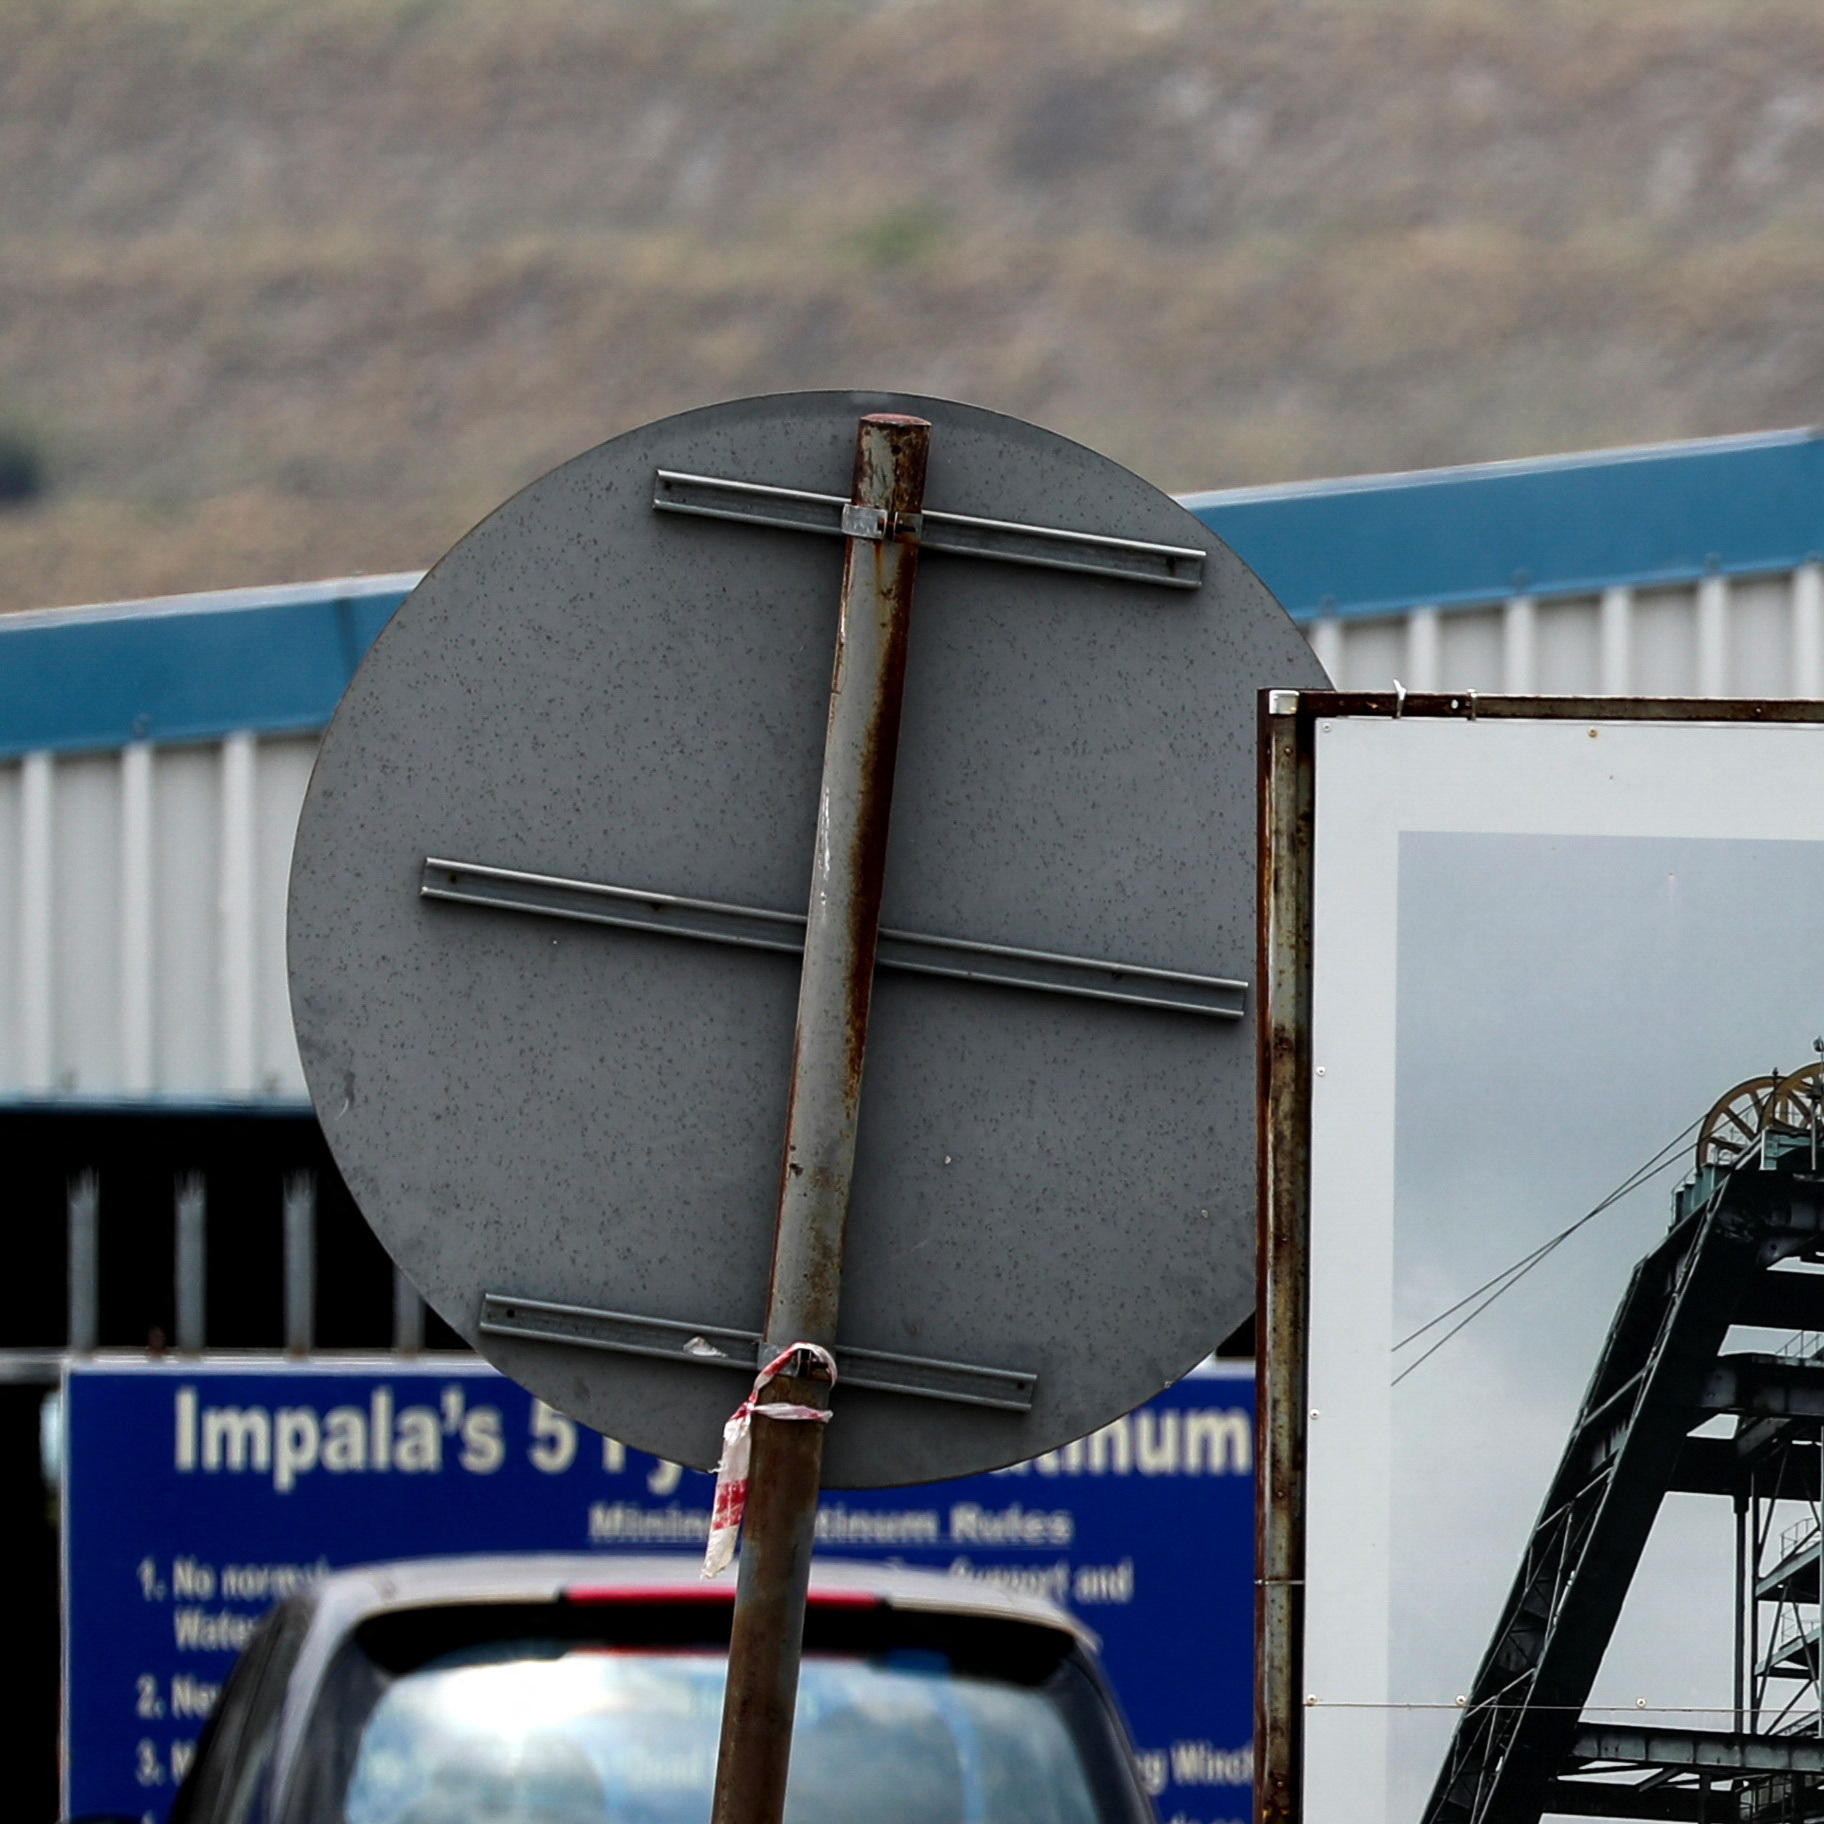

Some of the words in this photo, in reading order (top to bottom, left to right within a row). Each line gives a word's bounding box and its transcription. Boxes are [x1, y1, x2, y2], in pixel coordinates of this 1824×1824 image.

[174, 1386, 505, 1492] Impala's
[527, 1394, 580, 1474] 5
[951, 1502, 1074, 1543] Rules
[137, 1555, 167, 1601] 1.
[173, 1554, 217, 1601] No
[136, 1673, 167, 1720] 2.
